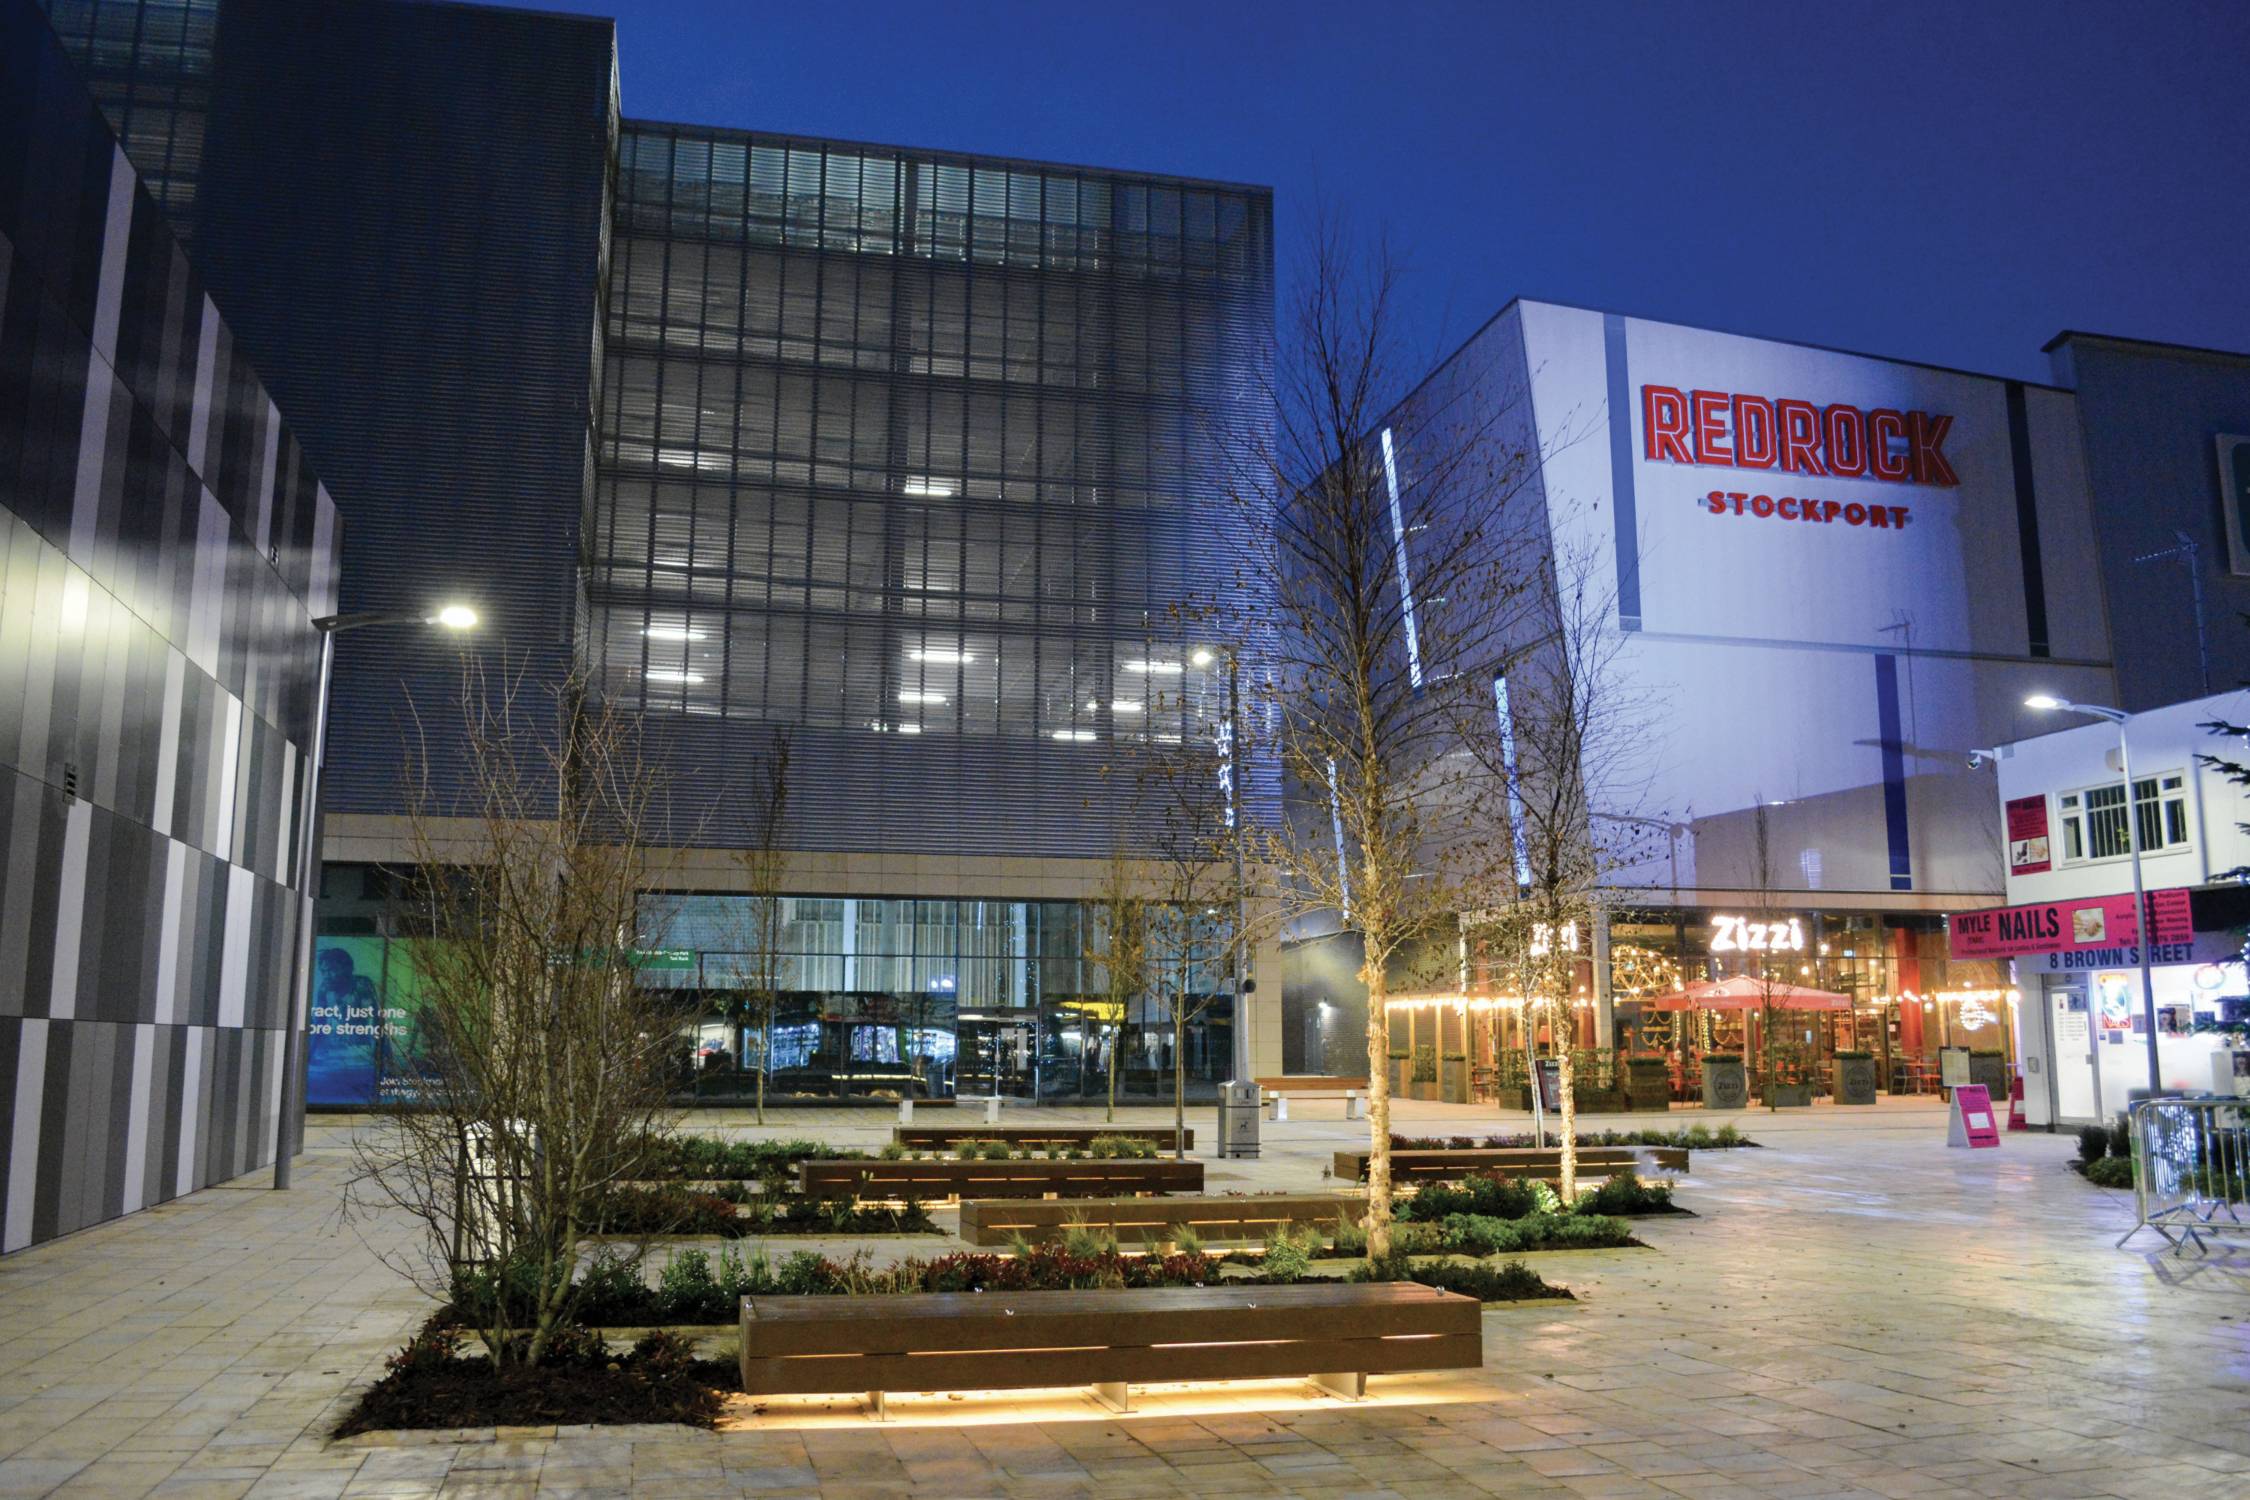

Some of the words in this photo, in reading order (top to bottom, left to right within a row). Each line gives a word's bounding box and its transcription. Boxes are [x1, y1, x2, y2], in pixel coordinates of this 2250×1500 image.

[1641, 384, 1960, 487] REDROCK
[1706, 491, 1910, 530] STOCKPORT
[1710, 915, 1804, 951] Zizzi
[1958, 914, 1991, 934] MYLE
[1998, 907, 2061, 942] NAILS
[2049, 952, 2059, 969] 8
[2063, 947, 2124, 968] BROWN
[2129, 943, 2194, 965] SREET
[346, 1004, 374, 1021] just
